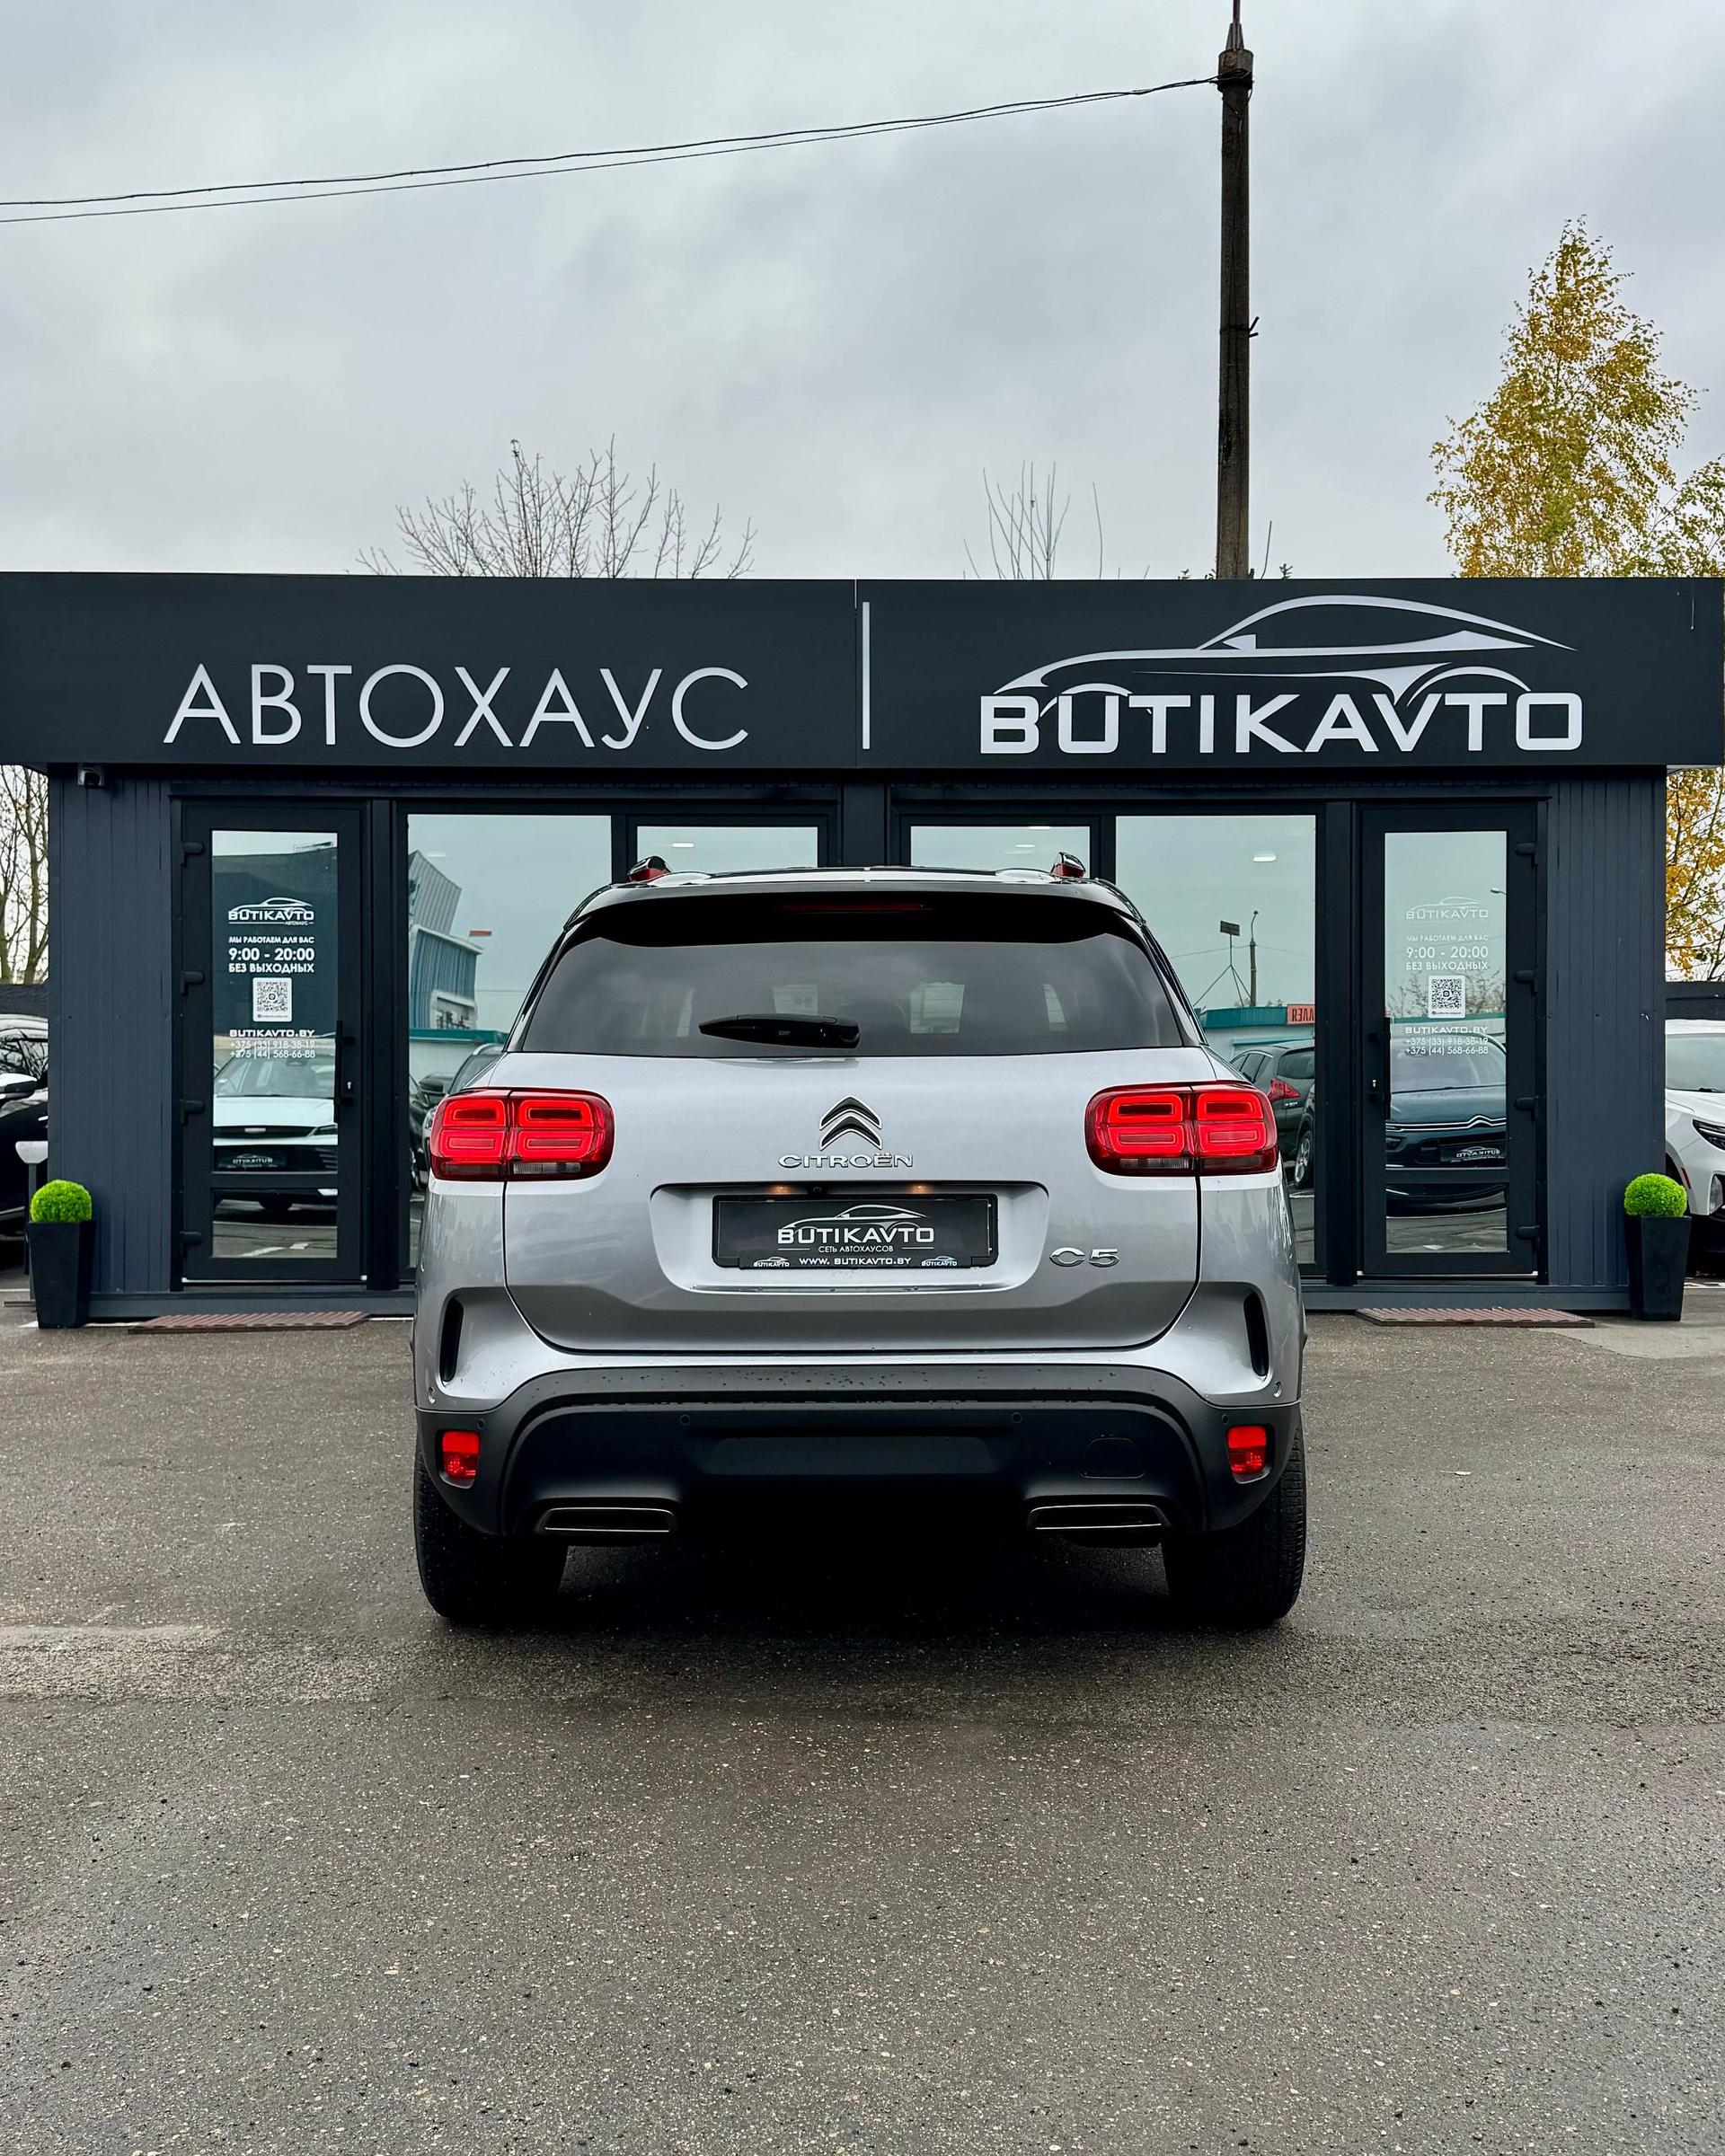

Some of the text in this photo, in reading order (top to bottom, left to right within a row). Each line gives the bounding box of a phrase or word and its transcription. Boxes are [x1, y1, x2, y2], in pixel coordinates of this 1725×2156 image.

[164, 664, 748, 749] АВТОХАУС
[981, 693, 1582, 754] BUTIKAVTO
[228, 910, 314, 921] BUTIKAVTO
[1405, 909, 1488, 919] BUTIKAVTO
[228, 948, 260, 961] 9:00
[274, 948, 314, 961] 20:00
[1406, 947, 1436, 959] 9:00
[1450, 946, 1488, 959] 20:00
[228, 963, 314, 974] БЕЗ ВЫХОДНЫХ
[1406, 961, 1488, 970] БЕЗ ВЫХОДНЫХ
[229, 1029, 315, 1038] BUTIKAVTO.BY
[230, 1040, 252, 1048] +375
[1406, 1038, 1488, 1047] +375 (33) 918-38-19
[230, 1049, 315, 1059] +375 (44) 568-66-88
[1406, 1047, 1488, 1056] +375 (44) 568-66-88
[778, 1153, 913, 1169] CITROËN
[777, 1228, 934, 1244] BUTIKAVTO
[839, 1245, 894, 1253] АВТОХАУСОВ
[1049, 1247, 1119, 1268] C5
